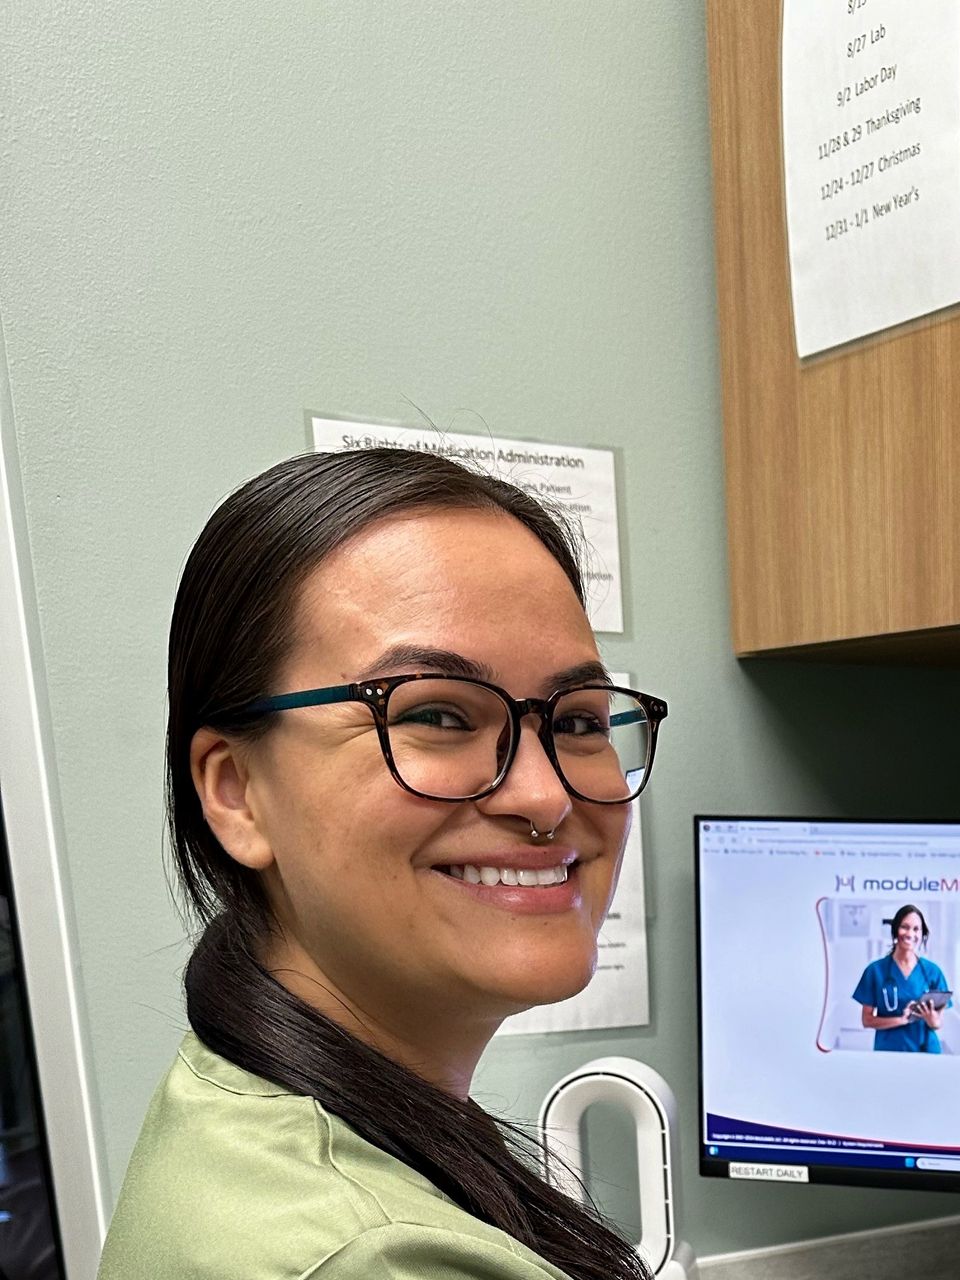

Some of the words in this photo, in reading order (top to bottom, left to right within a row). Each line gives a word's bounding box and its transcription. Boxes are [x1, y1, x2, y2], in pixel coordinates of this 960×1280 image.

[847, 34, 866, 58] 8/27
[870, 24, 886, 44] Lab
[837, 86, 850, 106] 9/2
[855, 74, 878, 96] Labor
[880, 64, 897, 82] Day
[819, 136, 841, 160] 11/28
[843, 131, 850, 147] &
[852, 125, 862, 142] 29
[866, 98, 921, 134] Thanksgiving
[822, 178, 844, 200] 12/24
[852, 162, 874, 186] 12/27
[878, 142, 920, 172] Christmas
[826, 218, 848, 240] 12/31
[856, 208, 868, 229] 1/1
[873, 204, 892, 219] New
[893, 186, 920, 209] Year's
[342, 435, 360, 448] Six
[498, 449, 584, 468] Administration
[730, 1166, 774, 1178] RESTART
[776, 1168, 804, 1178] DAILY
